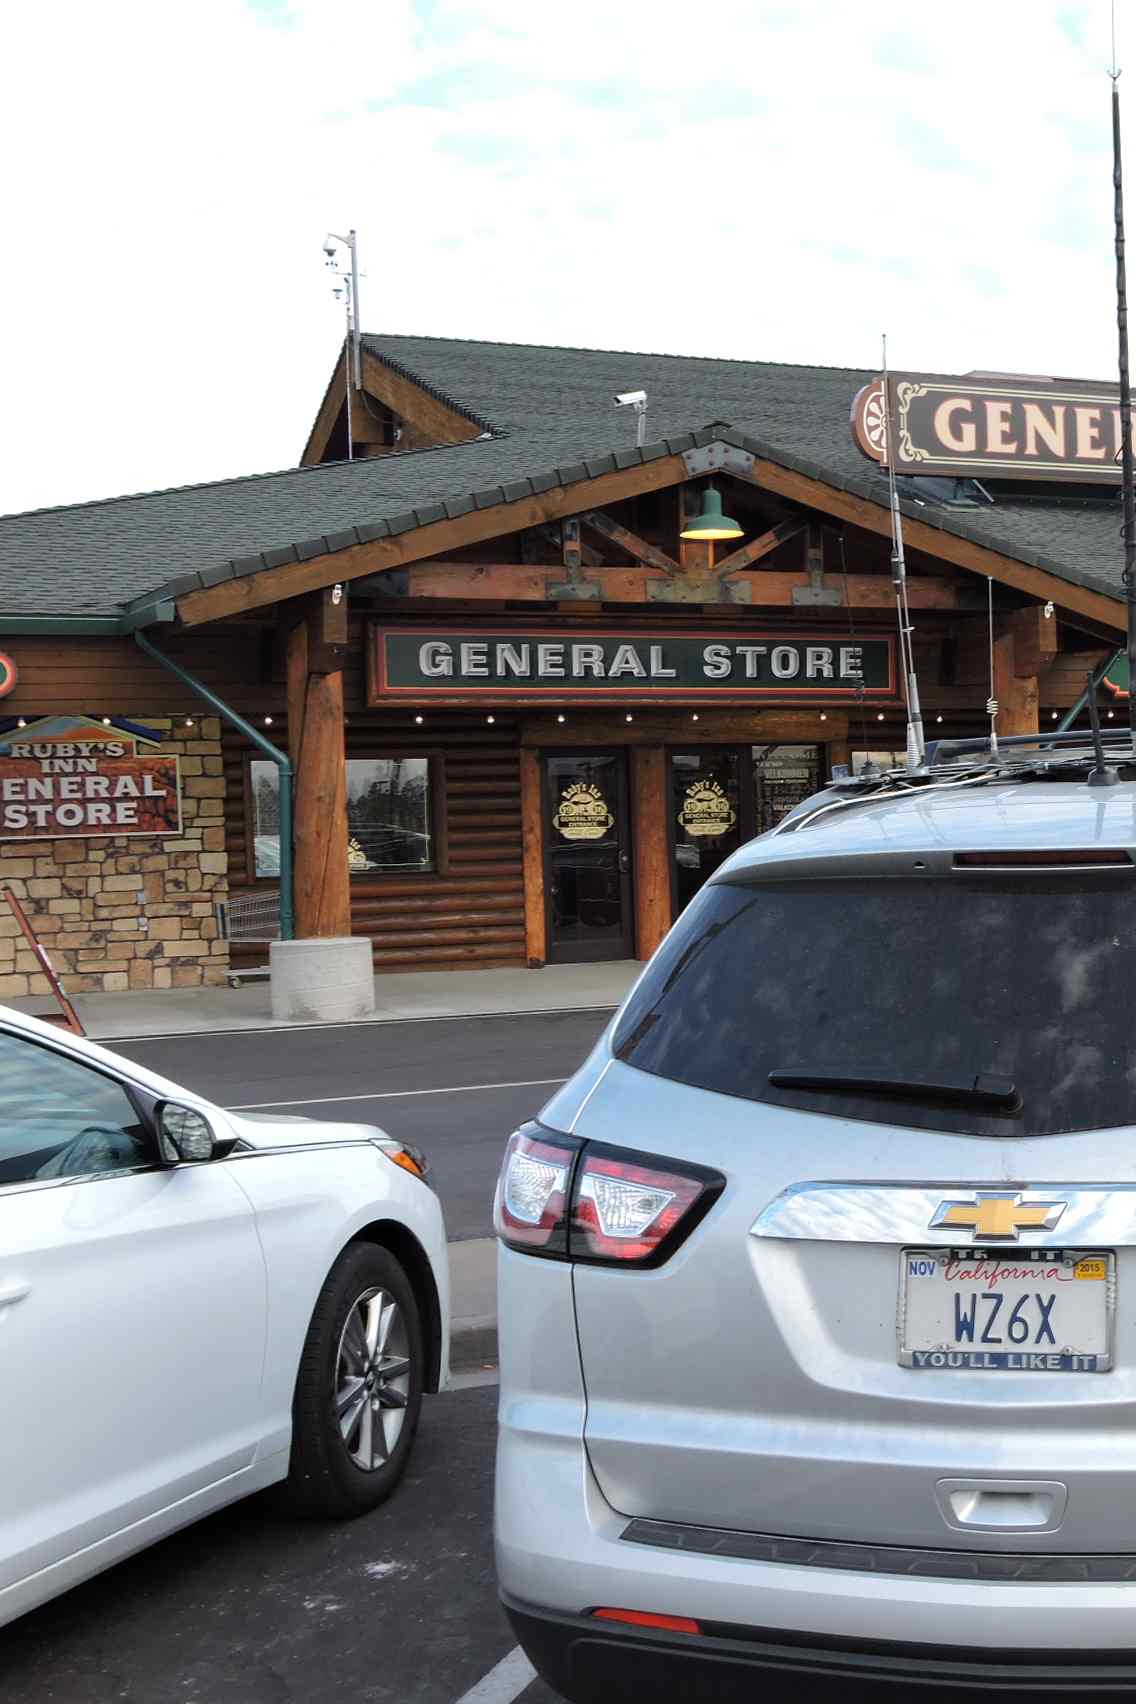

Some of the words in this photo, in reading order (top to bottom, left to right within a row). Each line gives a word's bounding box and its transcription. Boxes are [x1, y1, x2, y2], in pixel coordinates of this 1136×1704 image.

[418, 641, 677, 679] GENERAL
[703, 645, 864, 679] STORE
[10, 742, 126, 758] RUBY'S
[40, 758, 97, 773] INN
[0, 775, 167, 800] ENERAL
[3, 802, 139, 829] STORE
[909, 1261, 936, 1276] NOV
[943, 1259, 1074, 1289] California
[1079, 1263, 1101, 1272] 2015
[954, 1292, 1056, 1344] WZ6X
[914, 1352, 998, 1368] YOU'LL
[1007, 1353, 1061, 1369] LIKE
[1072, 1355, 1096, 1370] IT
